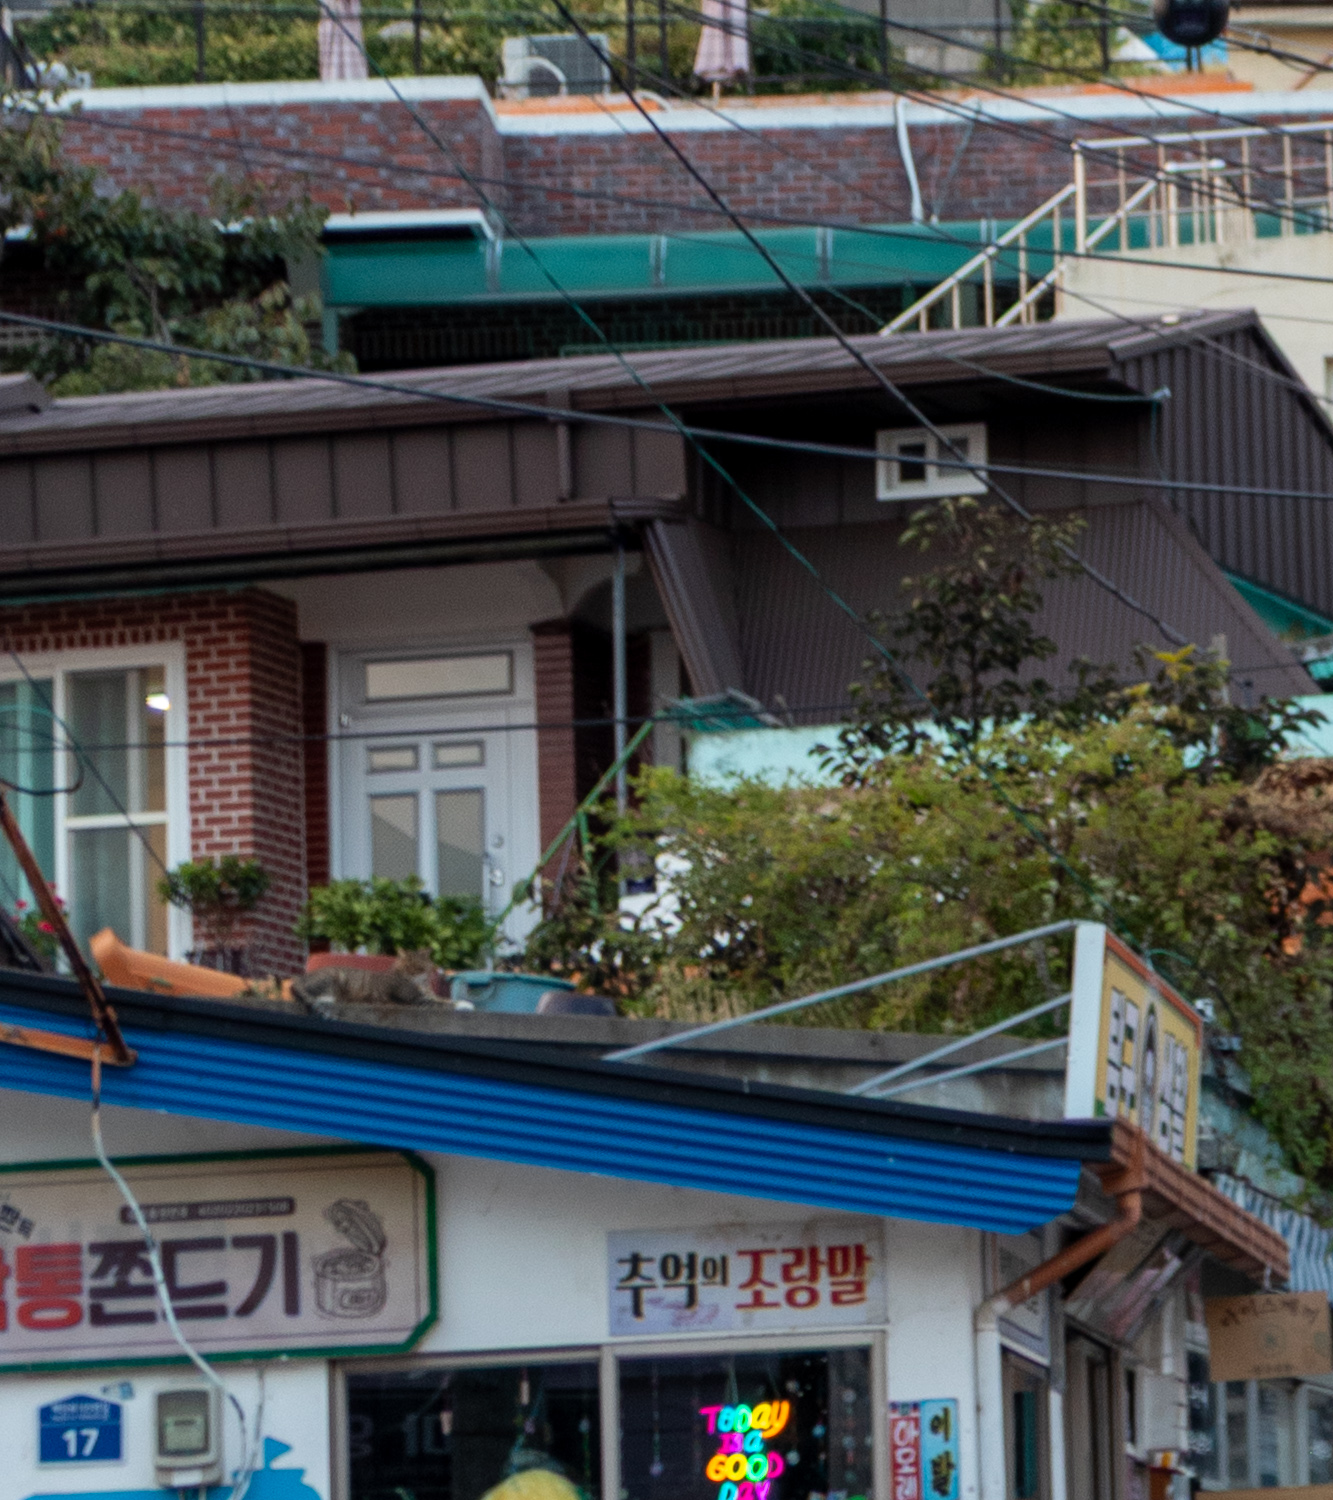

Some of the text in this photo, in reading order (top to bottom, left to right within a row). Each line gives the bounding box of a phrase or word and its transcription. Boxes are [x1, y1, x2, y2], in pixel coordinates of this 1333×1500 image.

[0, 1231, 301, 1331] 통쫀드기
[615, 1242, 872, 1320] 추억의 조랑말
[62, 1428, 100, 1458] 17
[705, 1451, 785, 1482] GOOD
[930, 1405, 956, 1498] 이발
